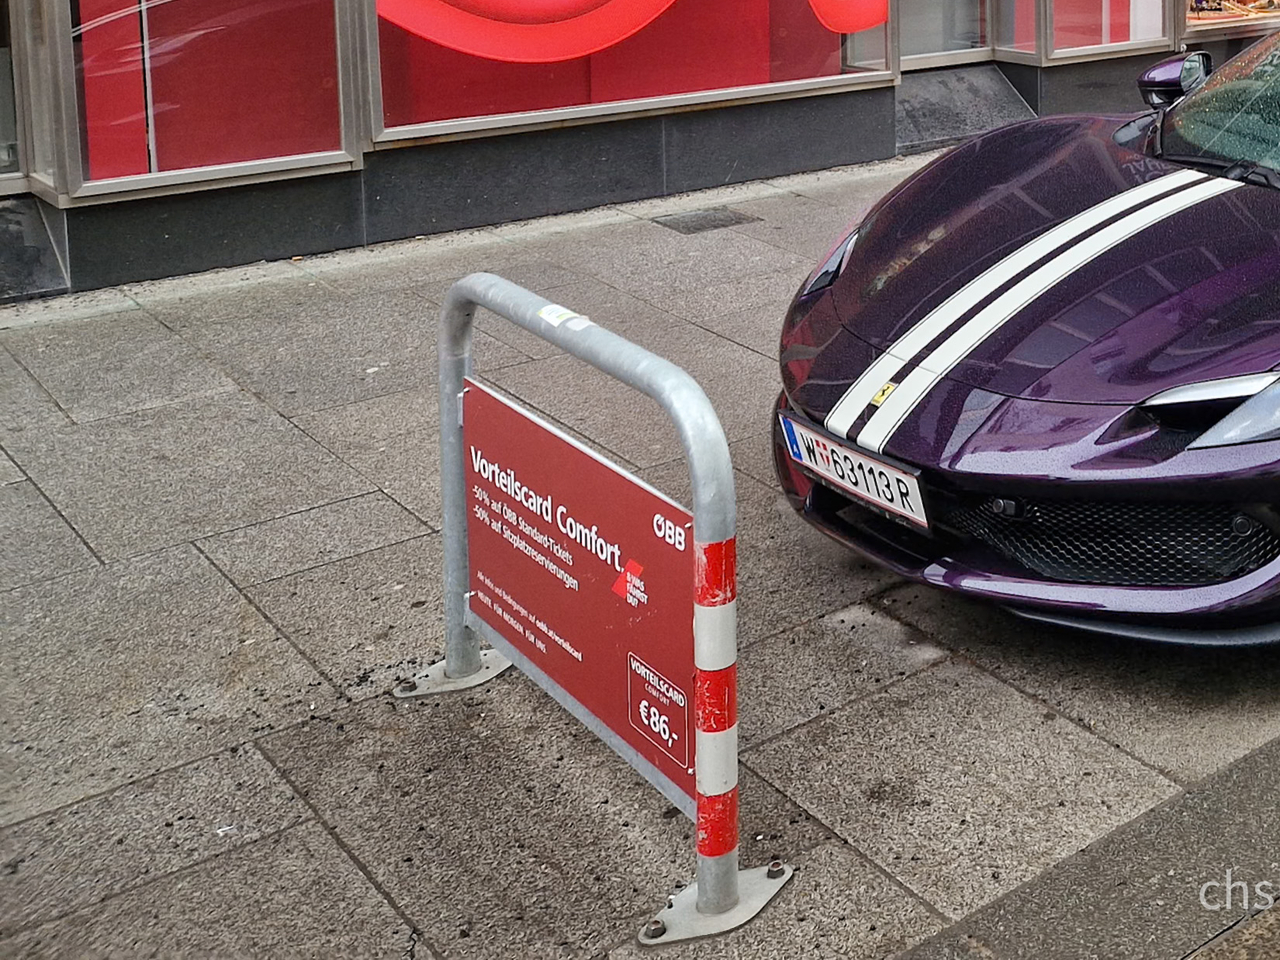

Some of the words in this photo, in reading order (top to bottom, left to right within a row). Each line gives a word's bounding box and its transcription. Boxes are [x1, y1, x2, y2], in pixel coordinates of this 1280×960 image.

[800, 431, 818, 466] W
[470, 445, 553, 523] Vorteilscard
[556, 505, 625, 573] Comfort.
[490, 499, 502, 514] auf
[518, 516, 574, 566] Standard-Tickets
[653, 513, 686, 551] ÖBB
[490, 518, 502, 534] auf
[502, 524, 579, 591] Sitzplatzreservierungen
[630, 656, 685, 707] VORTEILSCARD
[644, 683, 670, 707] COMFORT
